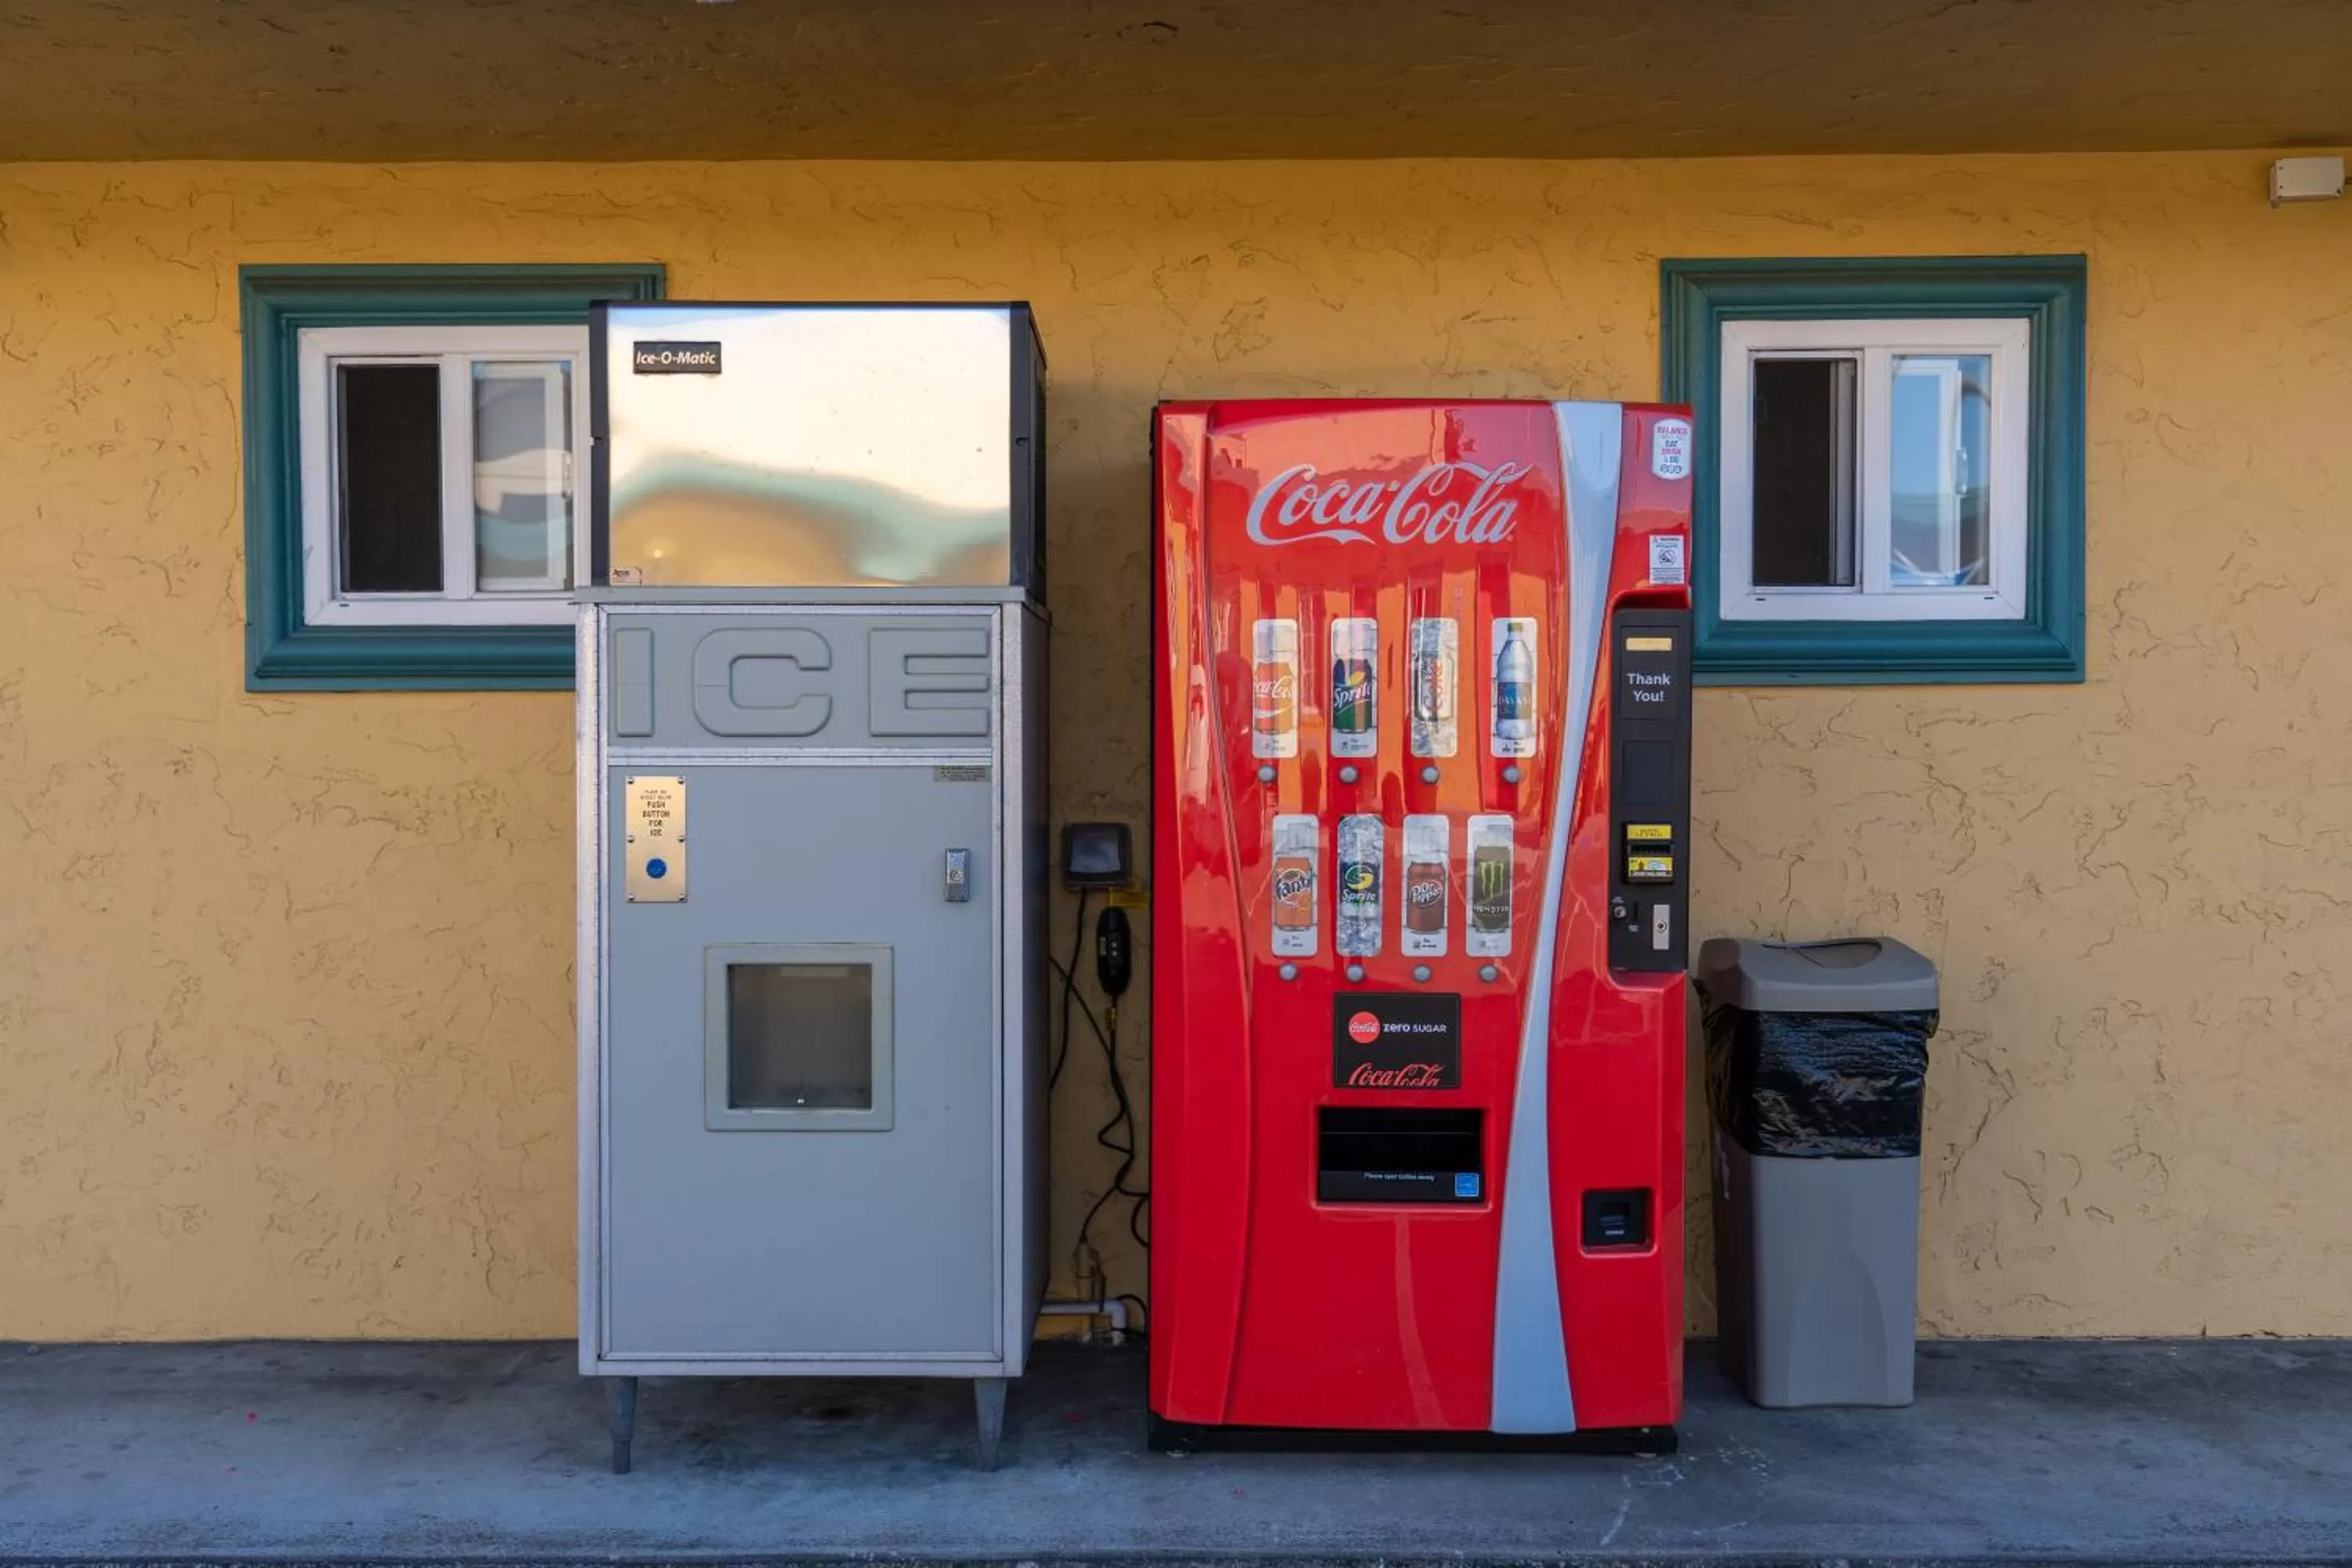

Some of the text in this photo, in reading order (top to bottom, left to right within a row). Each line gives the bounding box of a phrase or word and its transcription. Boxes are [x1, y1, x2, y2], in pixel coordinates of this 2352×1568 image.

[636, 350, 716, 365] Ice-O-Matic
[1247, 462, 1530, 546] Coca-Cola
[615, 626, 988, 737] ICE
[1627, 673, 1671, 685] Thank
[1633, 690, 1664, 702] You!
[1383, 1024, 1410, 1033] zero
[1413, 1024, 1446, 1033] SUGAR
